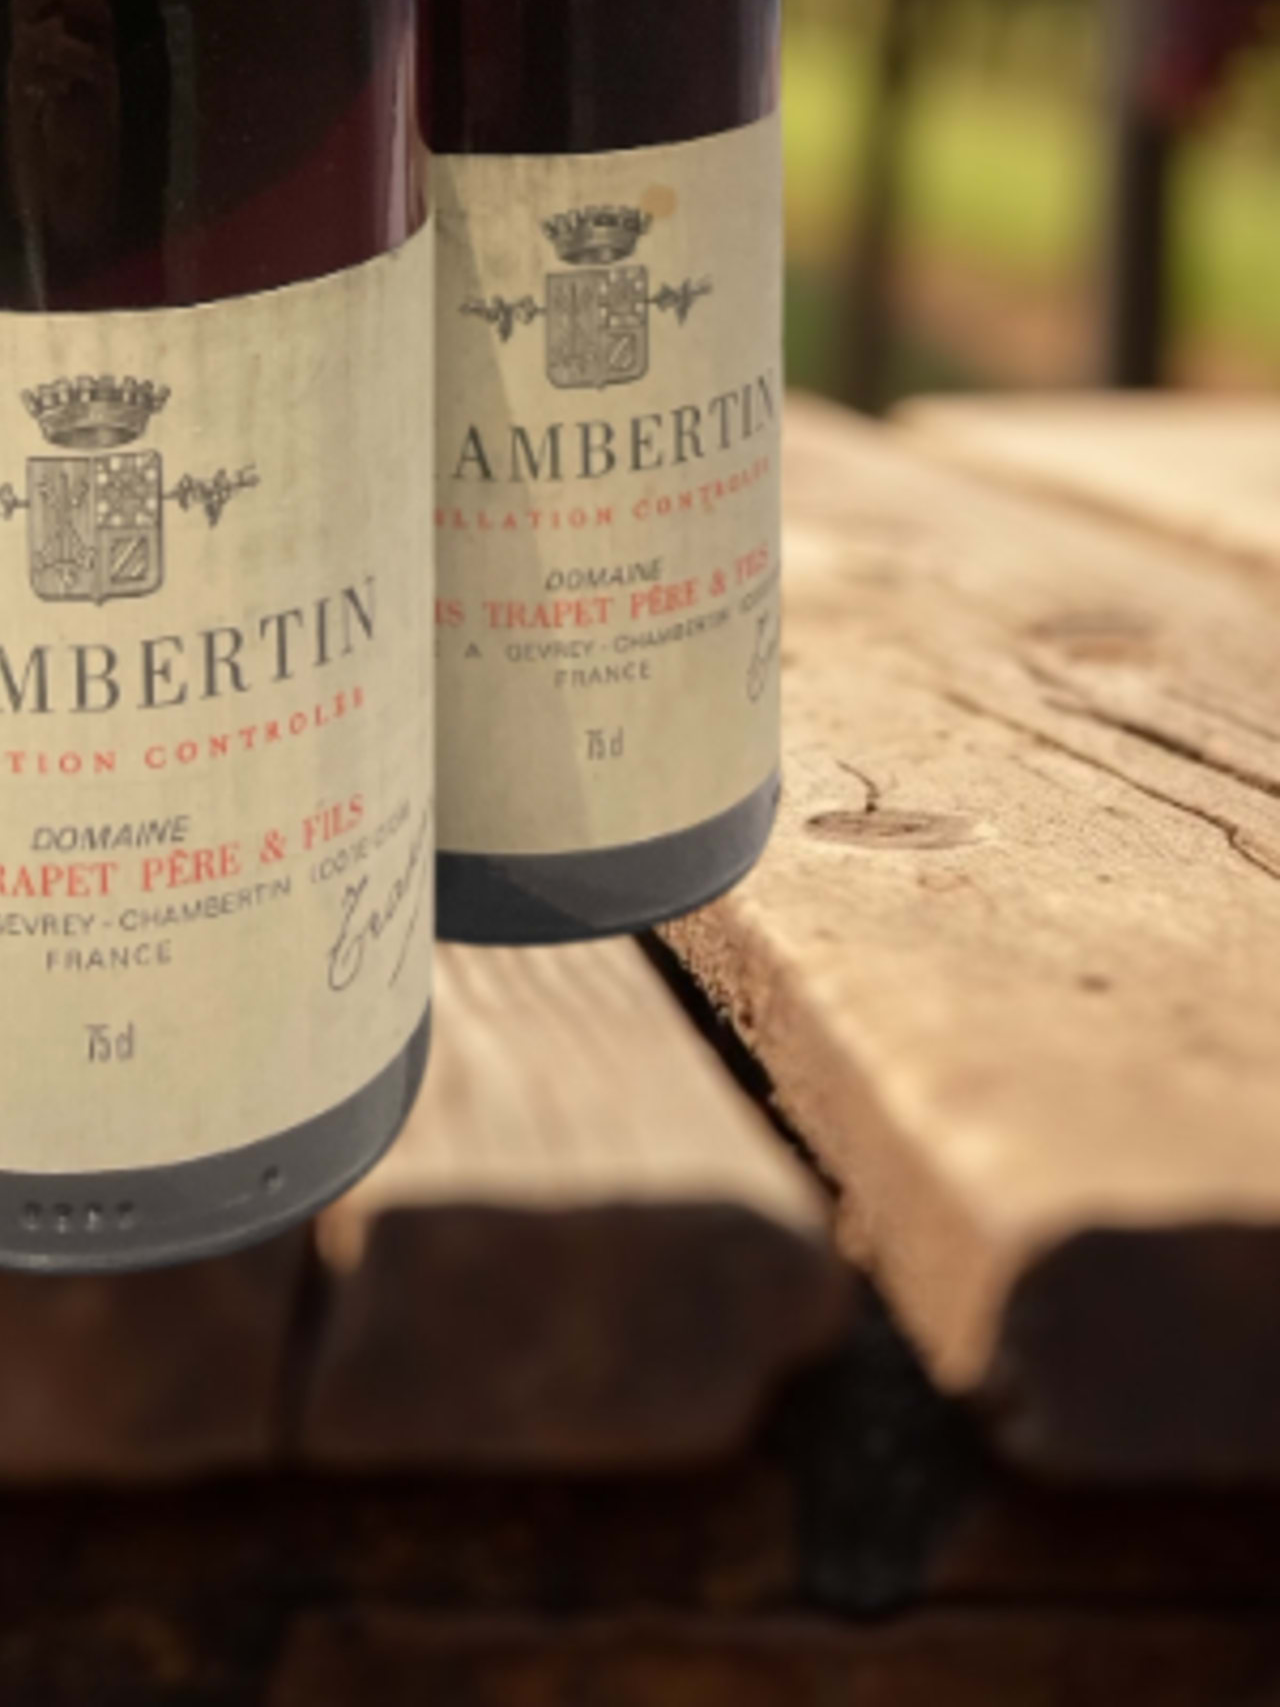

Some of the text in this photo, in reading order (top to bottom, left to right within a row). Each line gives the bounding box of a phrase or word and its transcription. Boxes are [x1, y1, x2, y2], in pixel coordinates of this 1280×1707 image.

[432, 366, 774, 482] AMBERTIN
[545, 556, 662, 592] DOMAINE
[482, 596, 615, 630] TRAPET
[553, 659, 652, 689] FRANCE
[30, 813, 190, 852] DOMAINE
[259, 828, 286, 865] &
[301, 793, 364, 851] FILS
[46, 939, 172, 972] FRANCE
